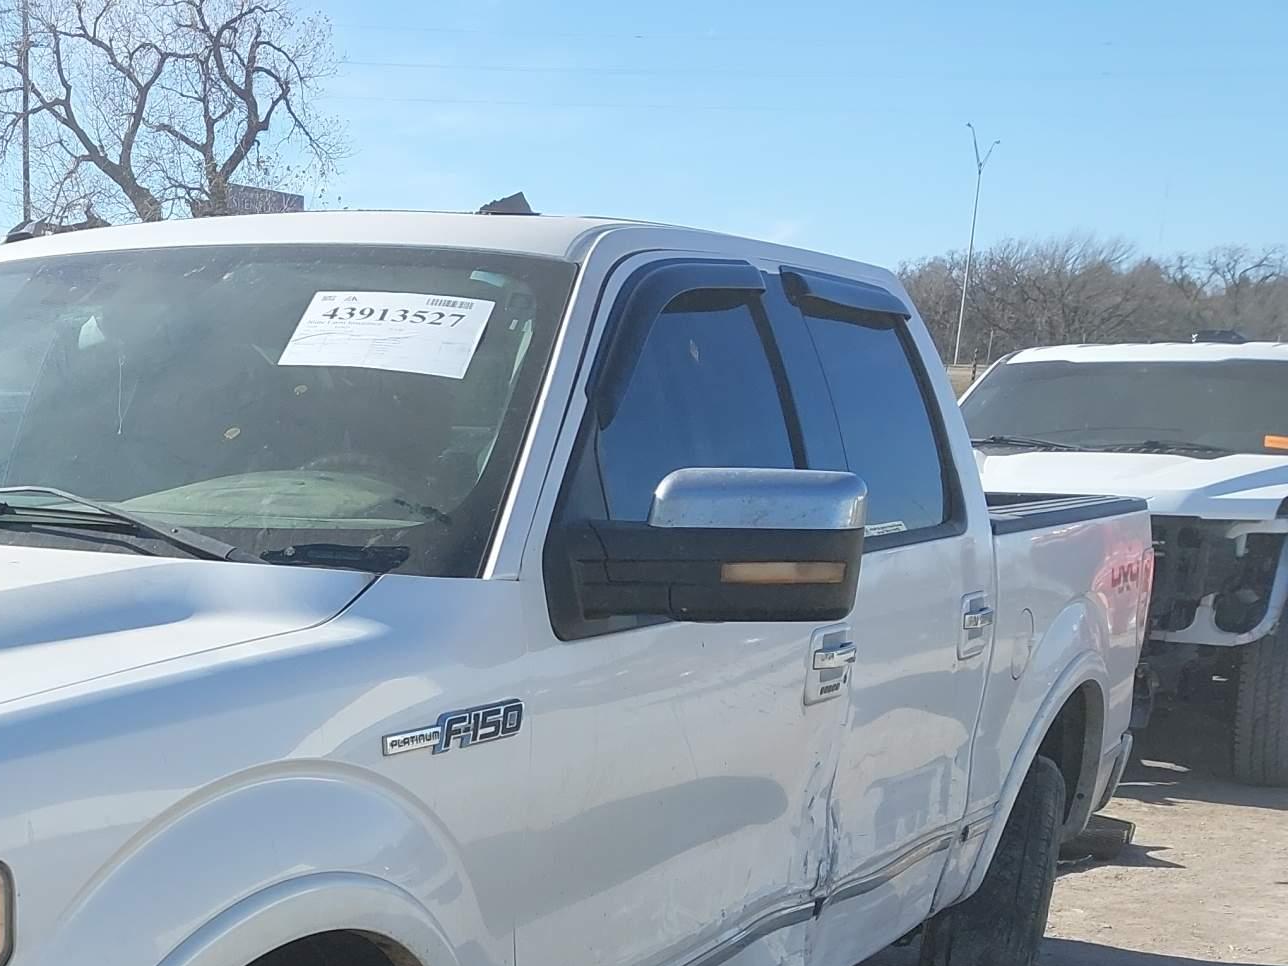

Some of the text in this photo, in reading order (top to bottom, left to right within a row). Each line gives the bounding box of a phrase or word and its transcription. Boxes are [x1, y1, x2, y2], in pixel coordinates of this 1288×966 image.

[322, 306, 466, 327] 43913527
[390, 700, 524, 752] PLATINUM F-150
